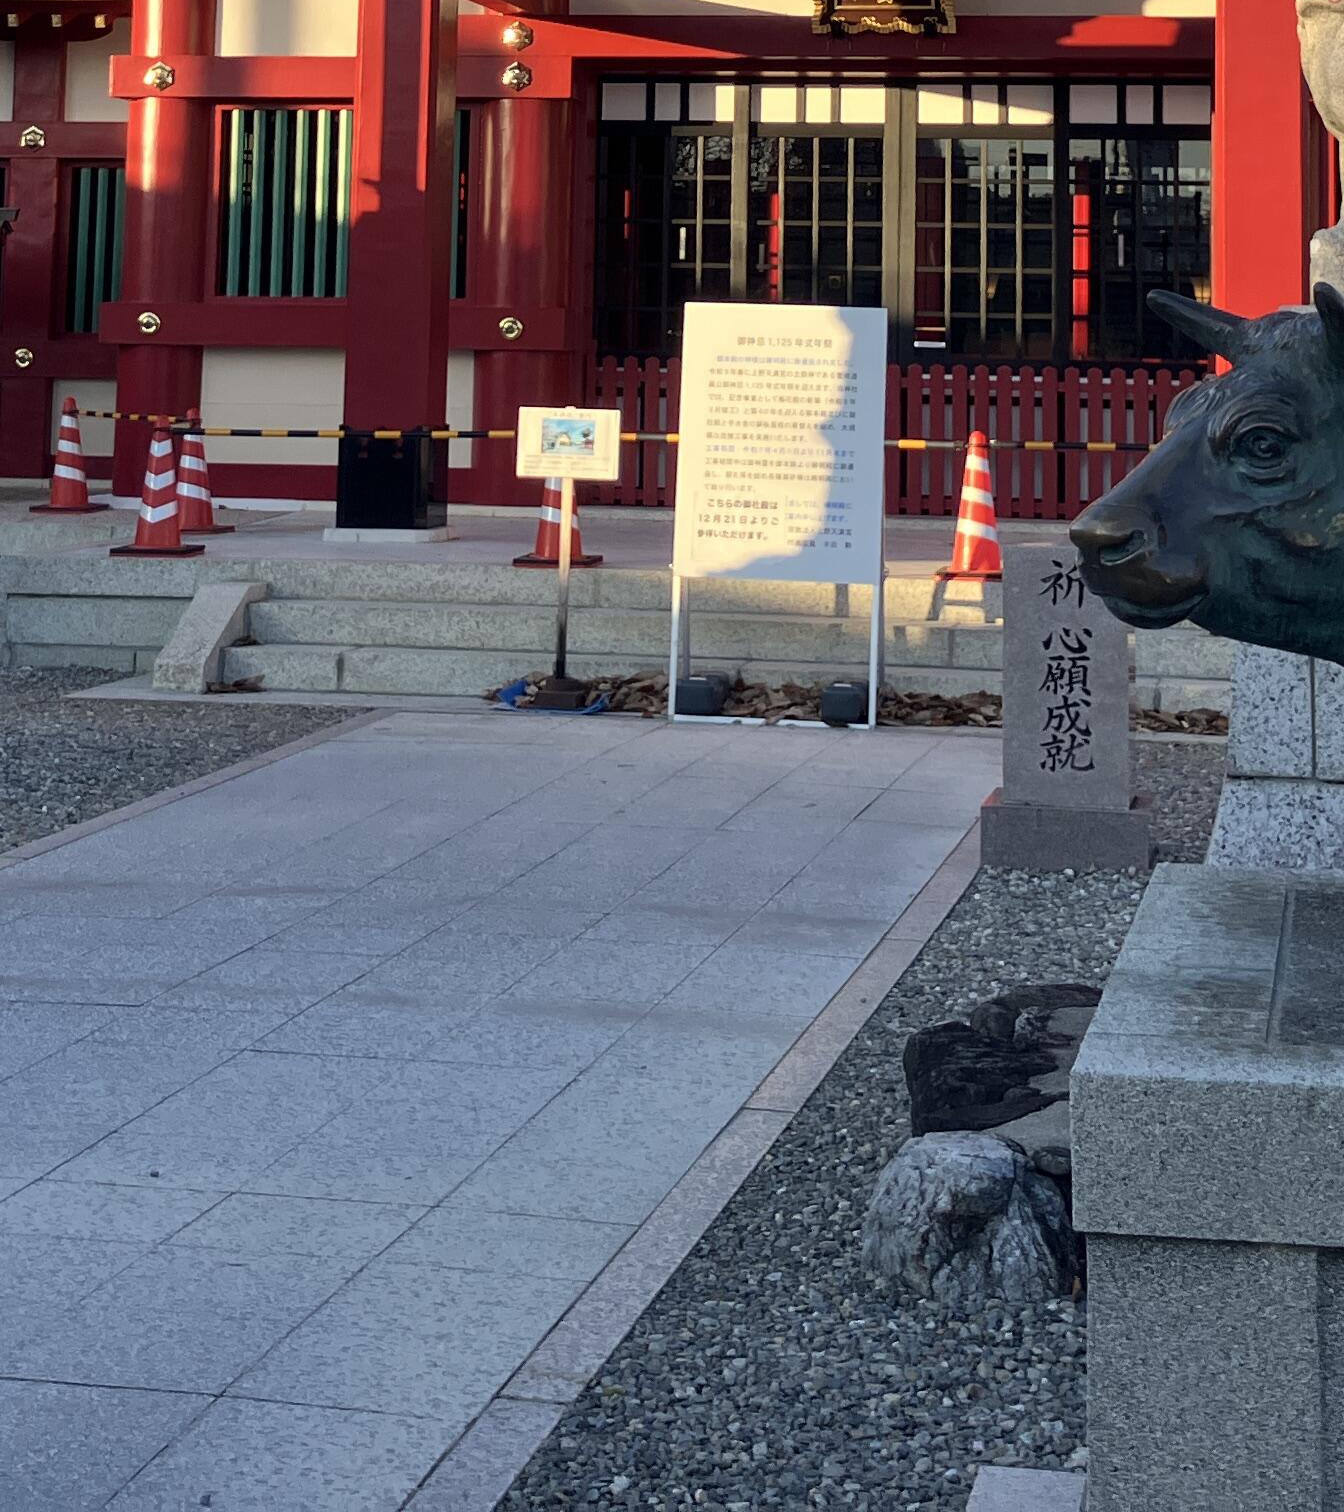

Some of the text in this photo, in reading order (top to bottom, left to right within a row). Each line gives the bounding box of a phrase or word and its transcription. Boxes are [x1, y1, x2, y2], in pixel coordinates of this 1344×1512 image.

[1038, 559, 1095, 773] 祈 心願成就
